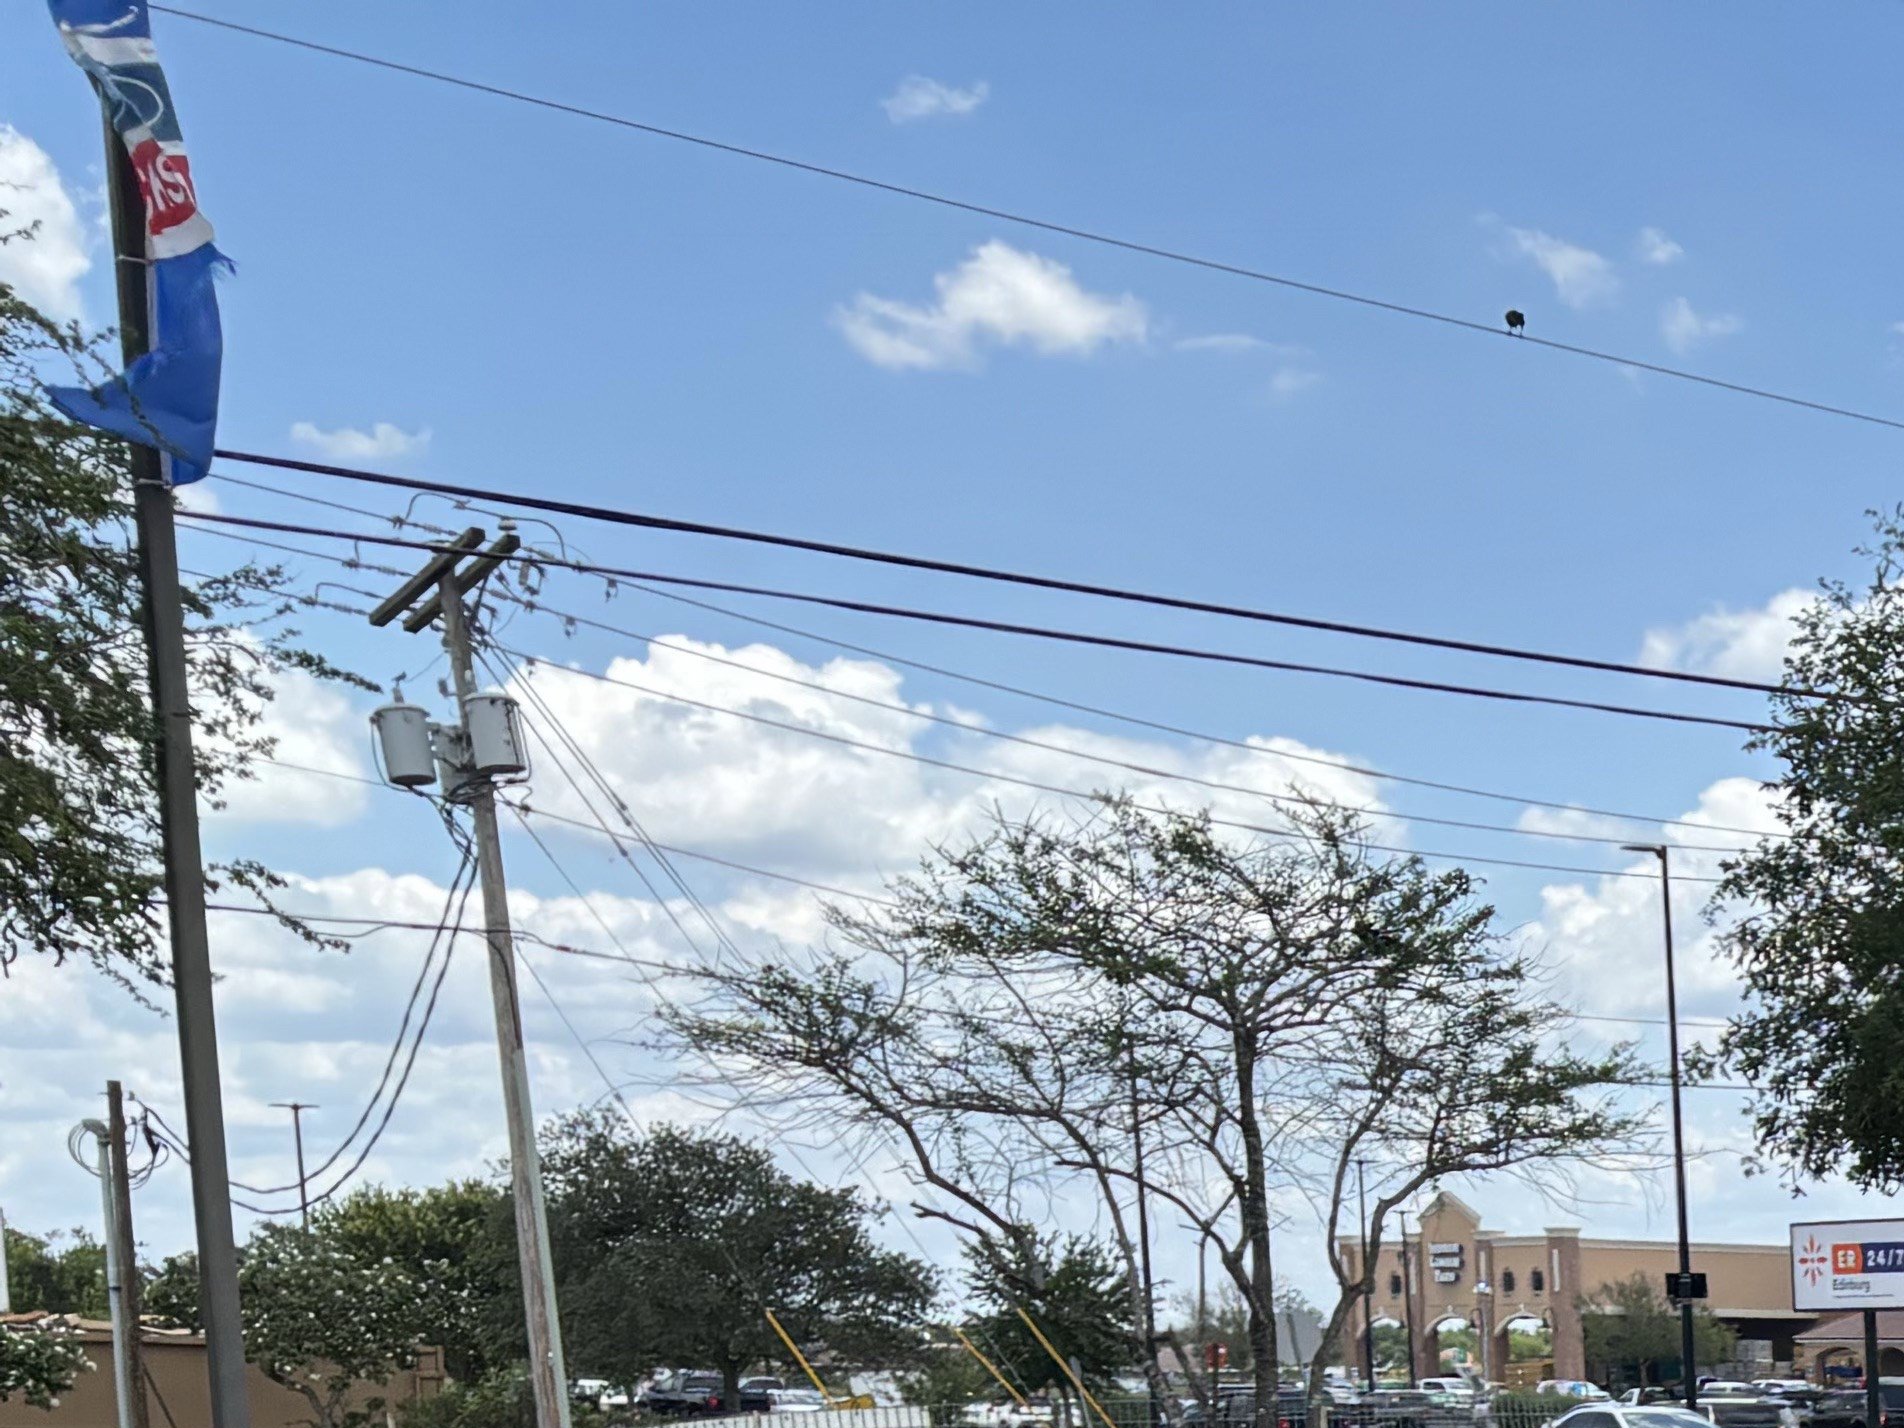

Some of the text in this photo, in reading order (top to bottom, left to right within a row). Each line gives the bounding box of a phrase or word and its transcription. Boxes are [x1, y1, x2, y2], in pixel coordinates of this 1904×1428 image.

[1837, 1248, 1904, 1269] ER 24/7
[1832, 1277, 1871, 1293] Edinburg
